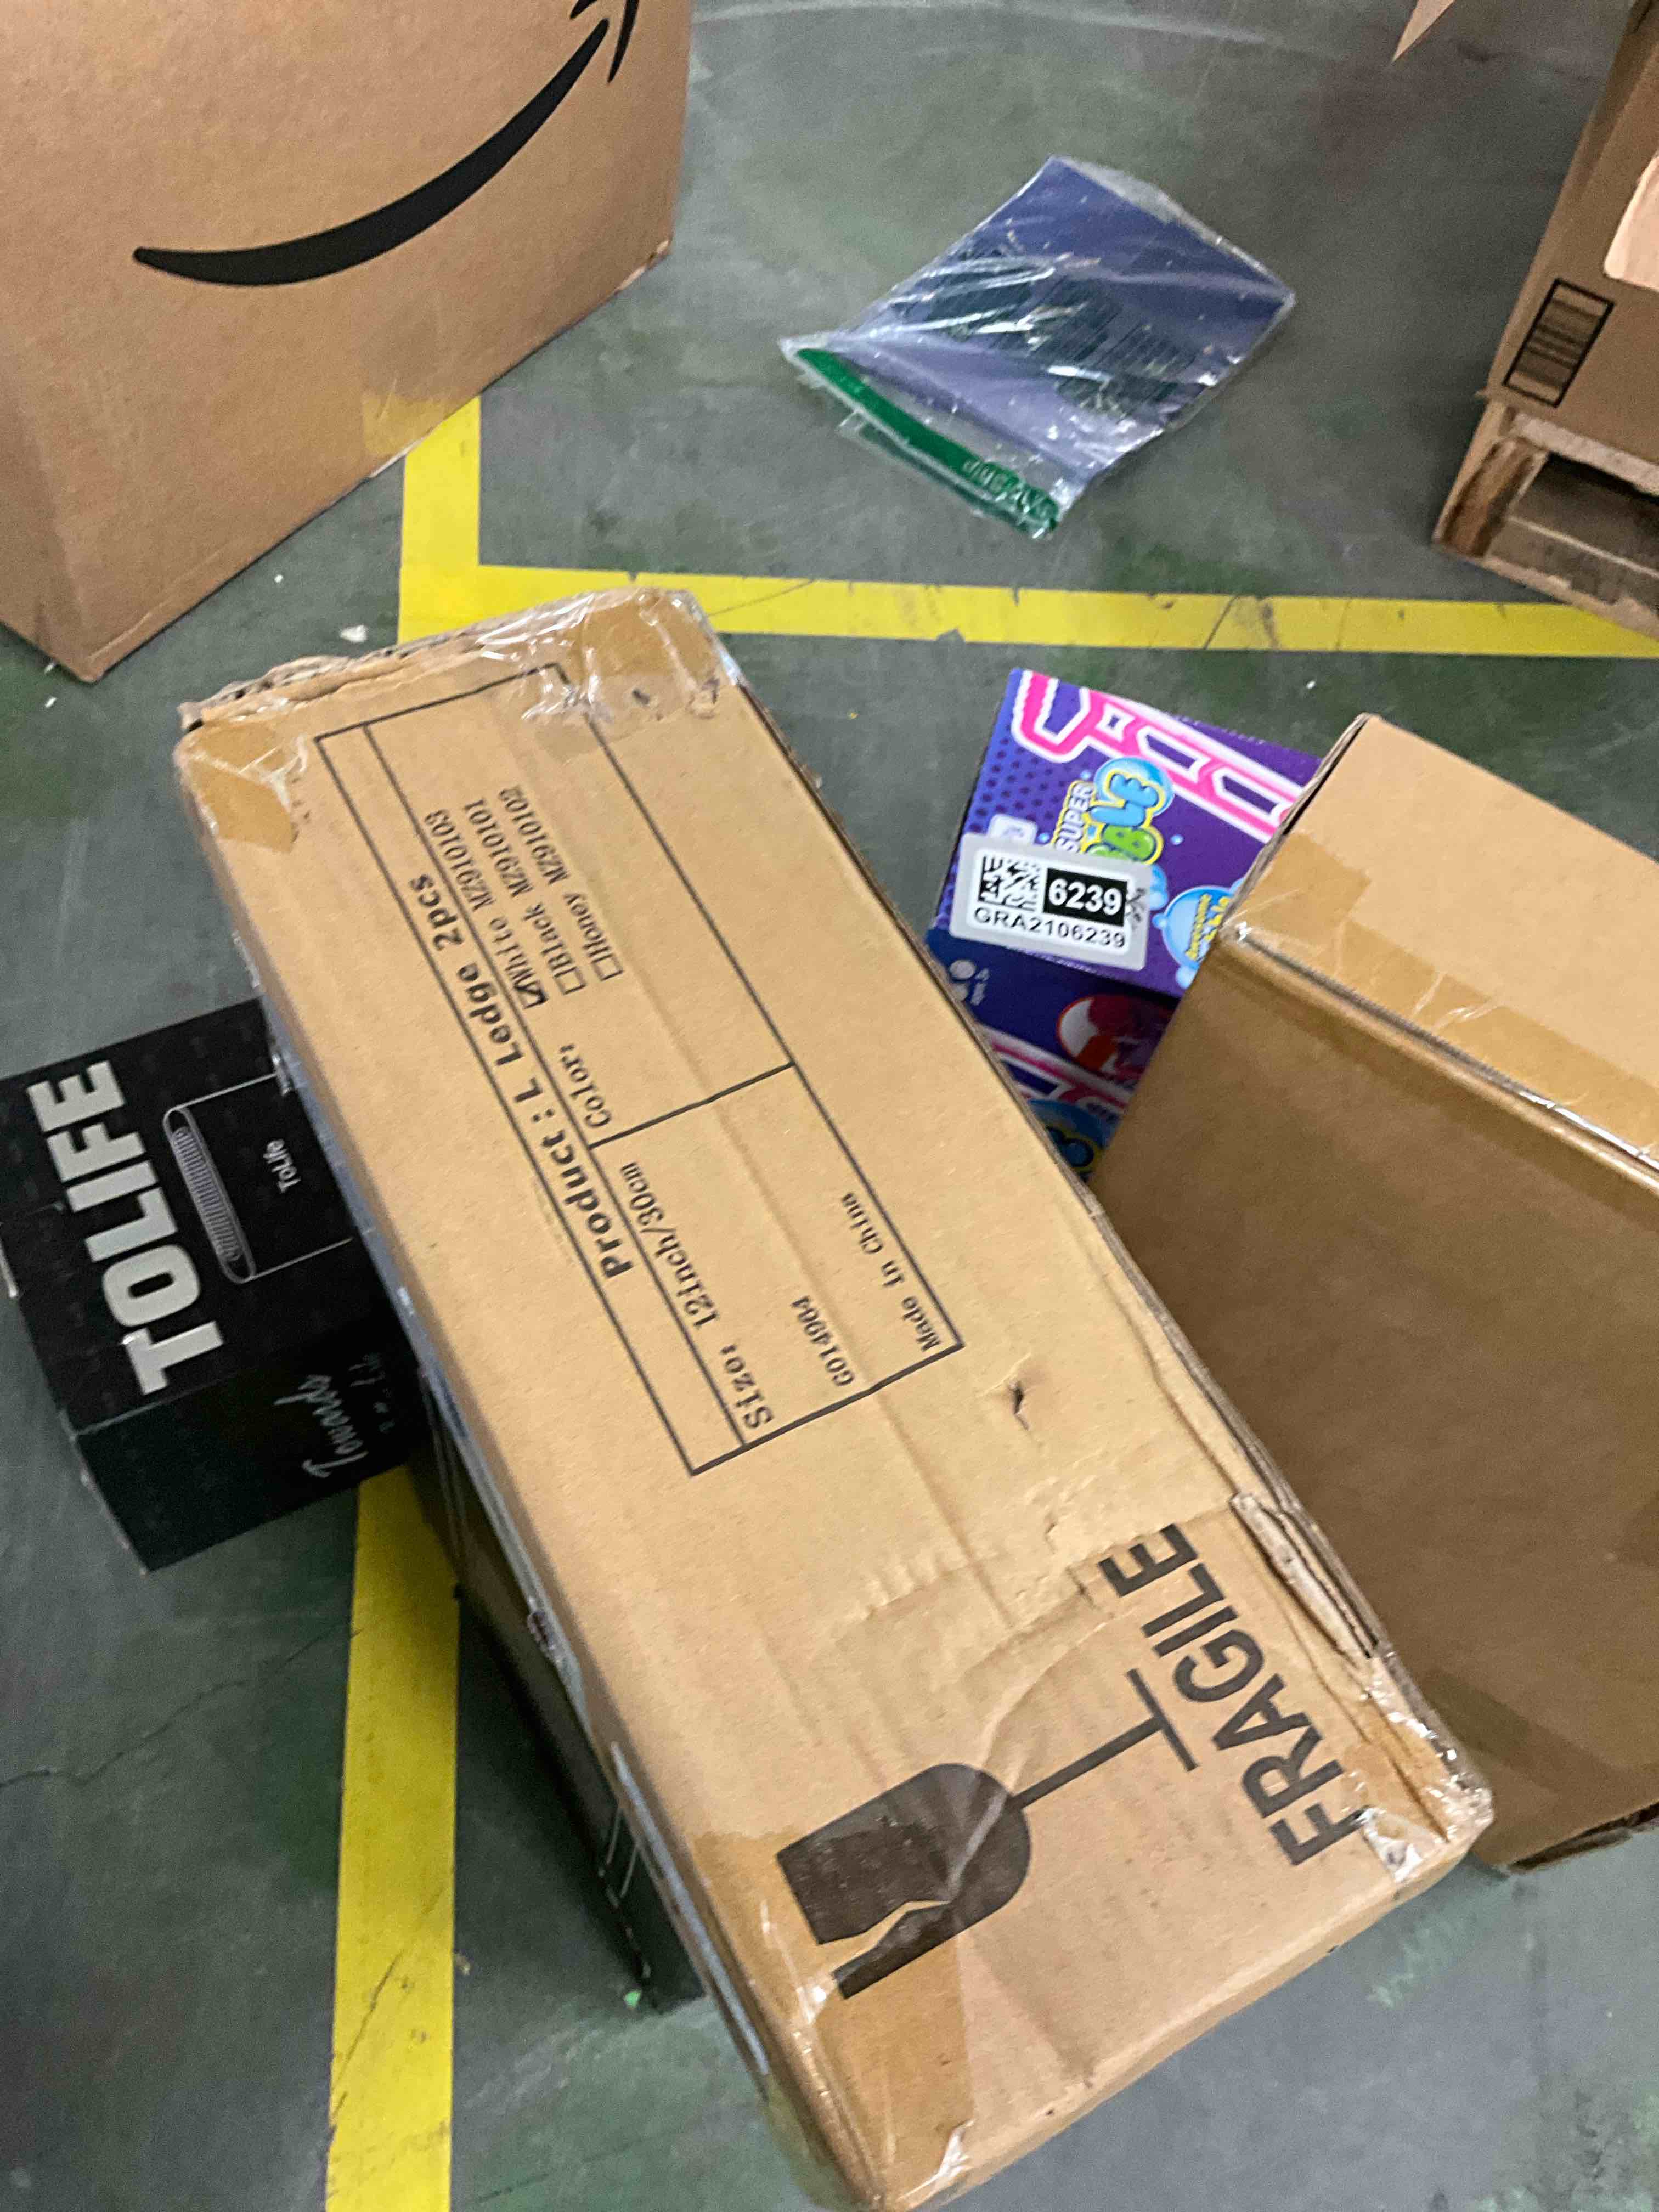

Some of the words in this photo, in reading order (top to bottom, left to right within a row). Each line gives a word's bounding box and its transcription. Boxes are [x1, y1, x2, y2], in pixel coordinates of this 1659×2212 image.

[463, 799, 533, 899] MZ910101
[498, 785, 571, 887] MZ910102
[1056, 784, 1096, 852] SUPER
[1086, 772, 1163, 864] BLE
[424, 809, 496, 912] MZ910103
[1048, 883, 1125, 916] 6239
[409, 873, 464, 951] 2pcs
[489, 916, 535, 985] White
[522, 901, 575, 973] Black
[561, 891, 611, 959] Honey
[974, 906, 1126, 950] GRA2106239
[457, 963, 523, 1066] Ledge
[558, 1044, 613, 1128] Color:
[26, 1059, 224, 1396] TOLIFE
[541, 1129, 634, 1279] Product
[620, 1161, 720, 1330] 12inch/30cm
[840, 1191, 884, 1255] China
[881, 1260, 905, 1288] in
[901, 1295, 943, 1353] Made
[720, 1344, 775, 1429] Size:
[1098, 1523, 1366, 1866] FRAGILE
